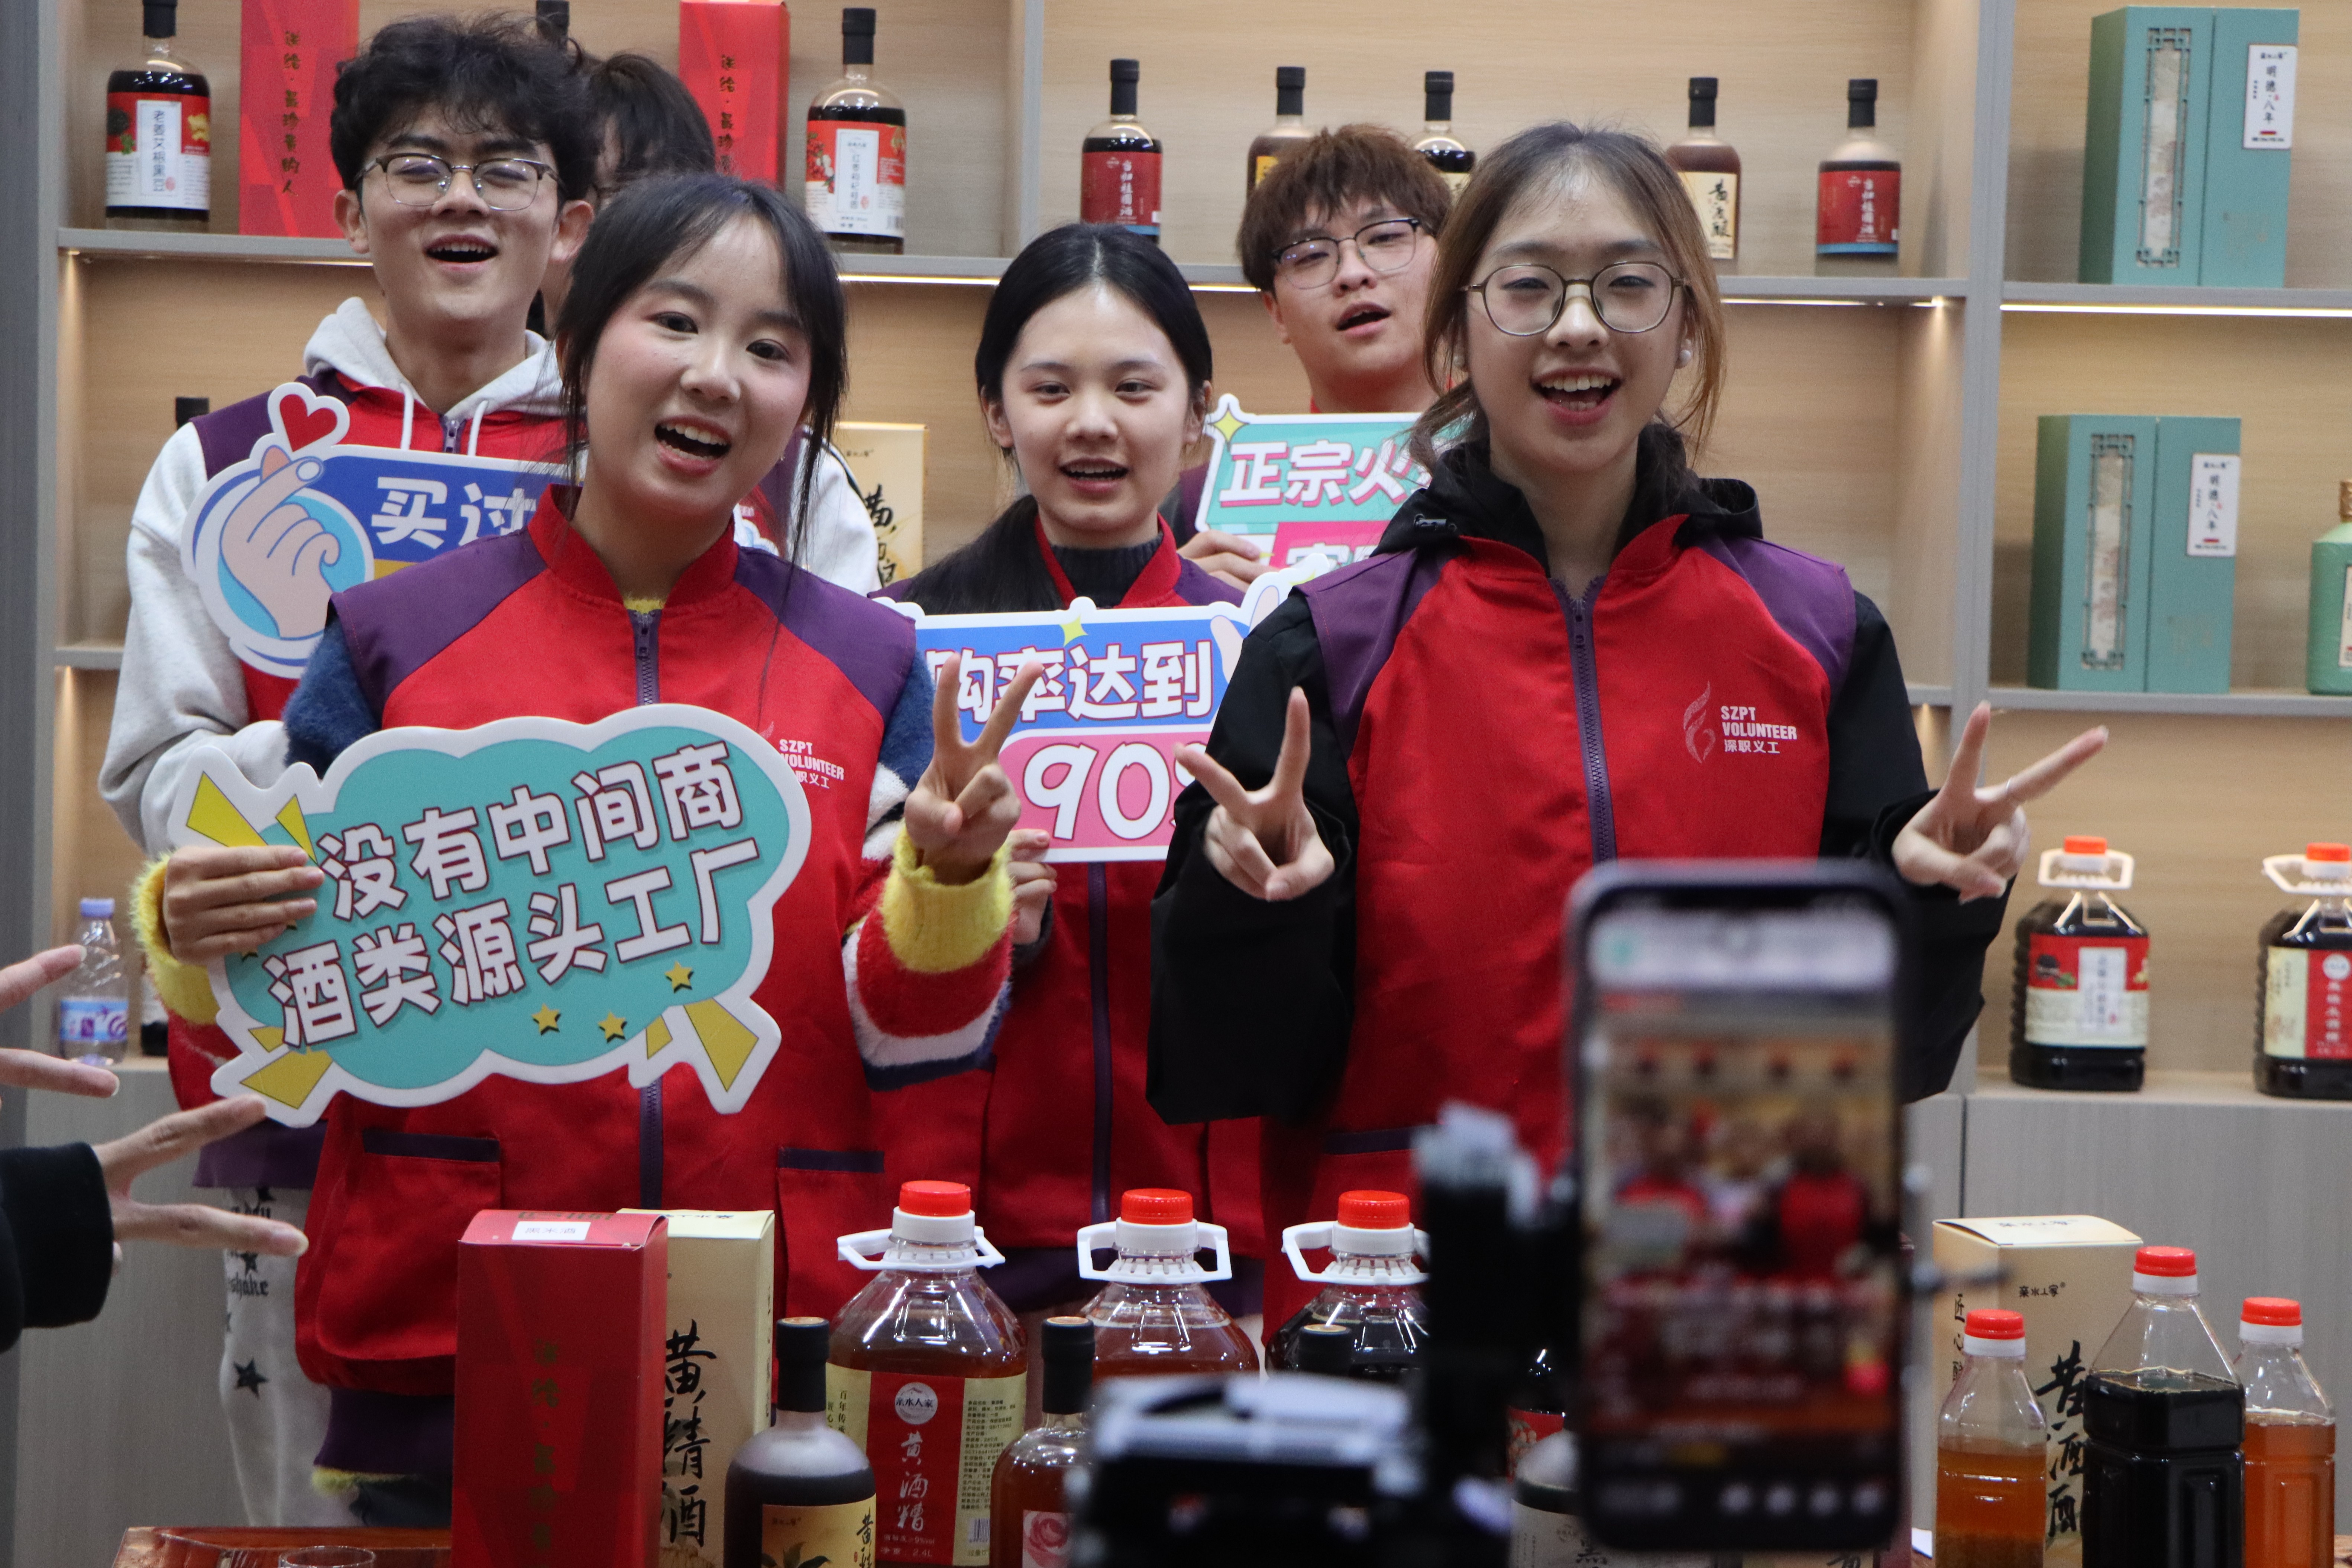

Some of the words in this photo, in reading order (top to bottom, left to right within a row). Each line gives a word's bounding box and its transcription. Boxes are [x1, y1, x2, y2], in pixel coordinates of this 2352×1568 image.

[1721, 705, 1756, 721] SZPT
[1722, 722, 1798, 740] VOLUNTEER
[779, 738, 813, 755] SZPT
[1724, 739, 1780, 754] 深职义工
[1022, 742, 1208, 840] 90
[316, 740, 744, 922] 没有中间商
[262, 838, 761, 1049] 酒类源头工厂
[897, 1431, 929, 1532] 黄酒糟
